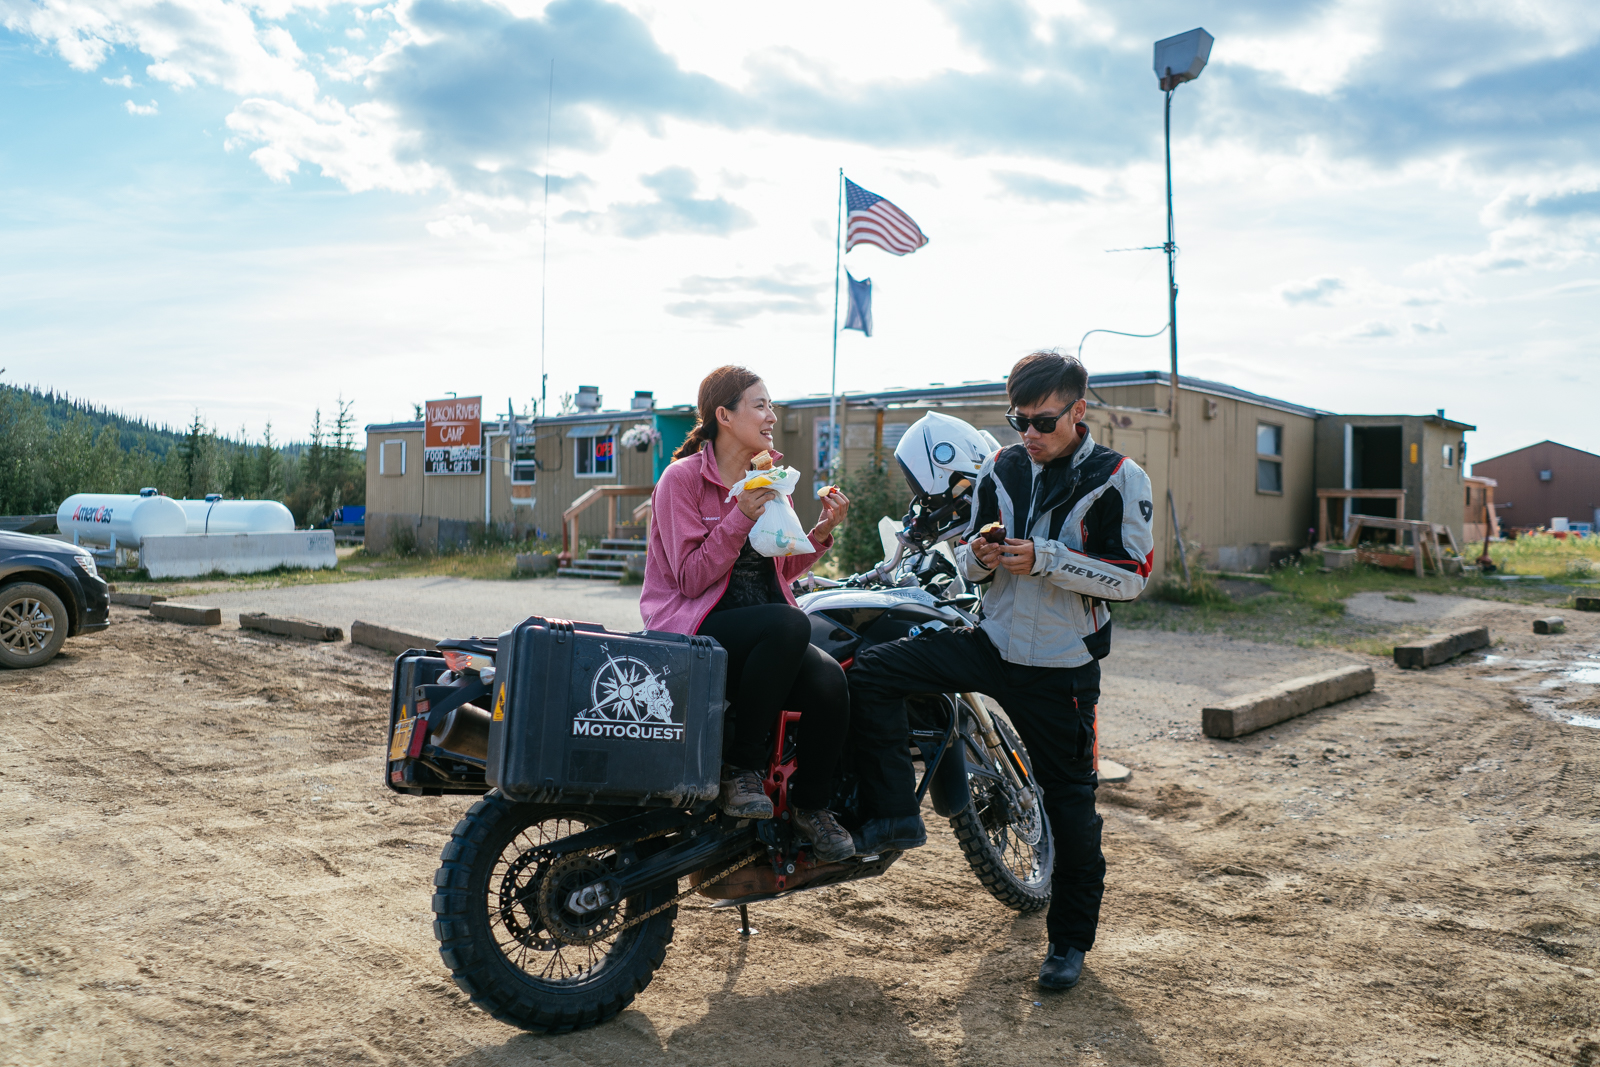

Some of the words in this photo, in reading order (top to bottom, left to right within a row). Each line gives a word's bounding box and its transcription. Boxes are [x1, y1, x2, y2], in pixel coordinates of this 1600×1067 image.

[426, 405, 455, 423] YUKON
[455, 403, 480, 421] RIVER
[440, 425, 465, 443] CAMP
[425, 449, 445, 462] FOOD
[595, 441, 613, 457] OPE
[432, 461, 449, 474] FUEL
[453, 460, 472, 473] GIFTS
[72, 504, 114, 524] AmeriGas
[600, 642, 609, 654] N
[662, 664, 671, 676] E
